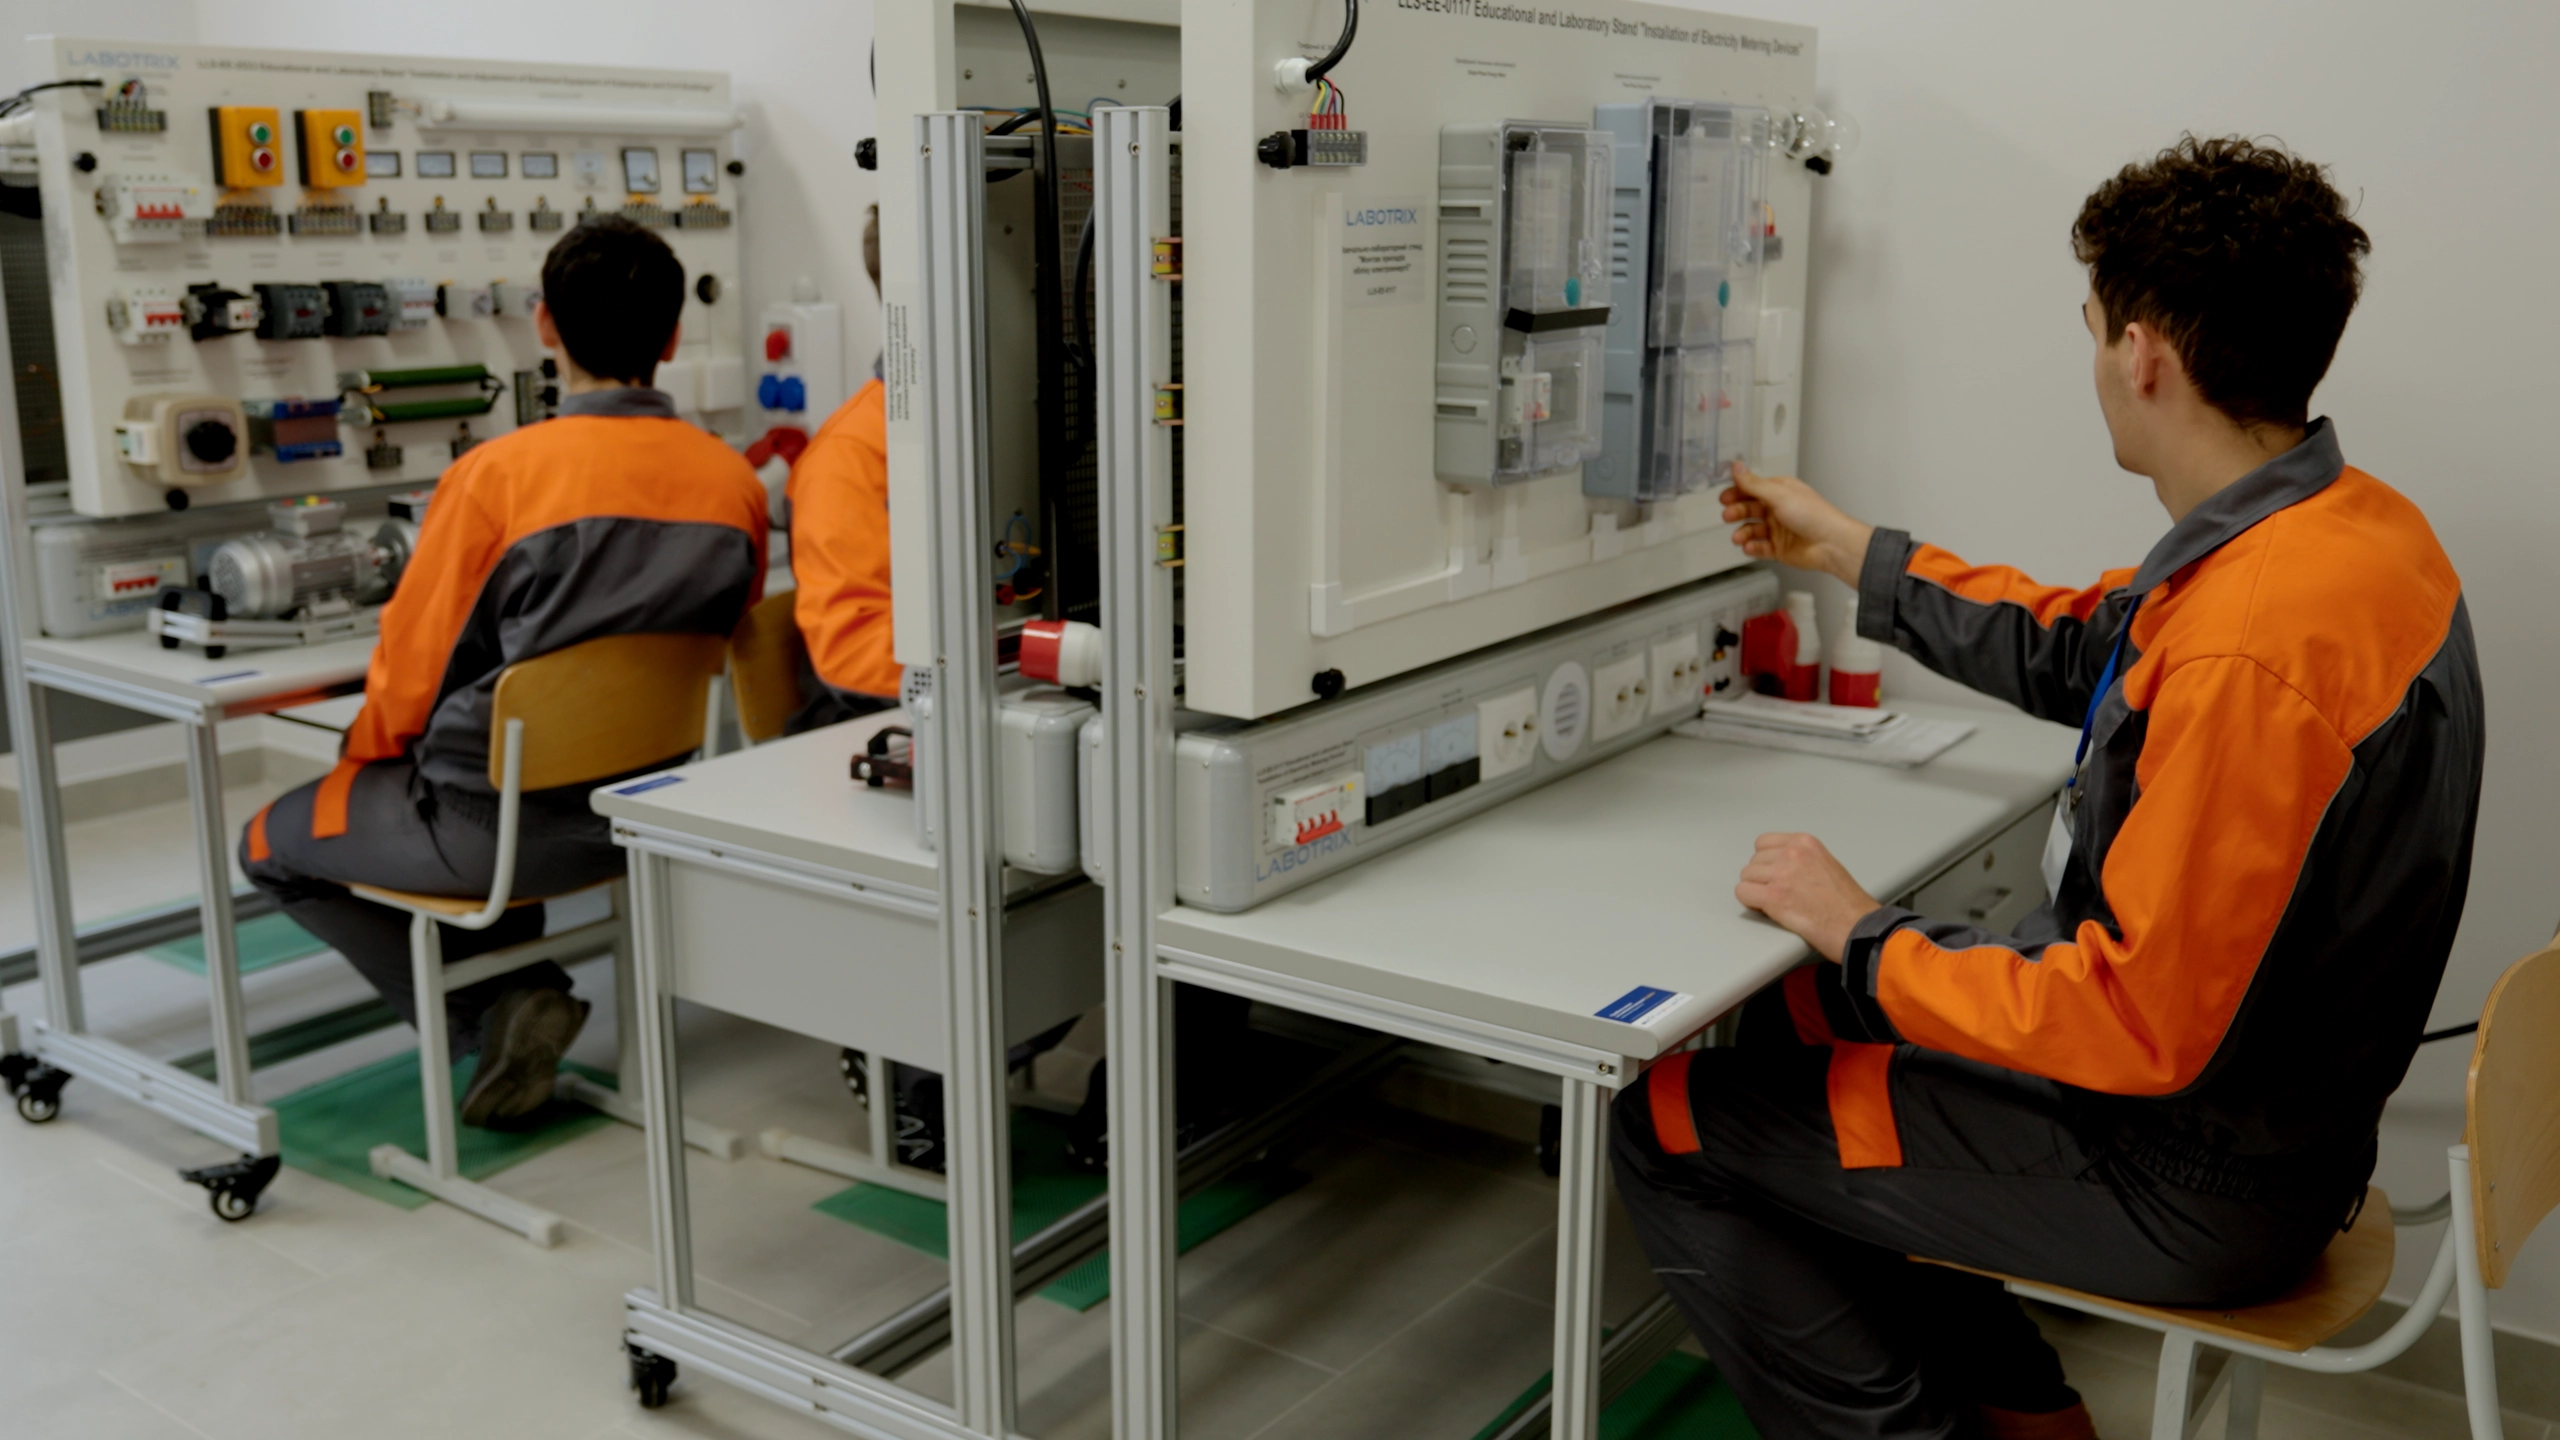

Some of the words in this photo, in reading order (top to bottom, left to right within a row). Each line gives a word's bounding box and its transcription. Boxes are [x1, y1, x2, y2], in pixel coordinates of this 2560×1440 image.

[1474, 0, 1537, 24] Educational
[1538, 11, 1557, 26] and
[1559, 12, 1611, 36] Laboratory
[1612, 18, 1639, 37] Stand
[1691, 29, 1700, 43] of
[67, 50, 180, 70] LABOTRIX
[1345, 208, 1418, 226] LABOTRIX
[1256, 829, 1353, 882] LABOTRIX
